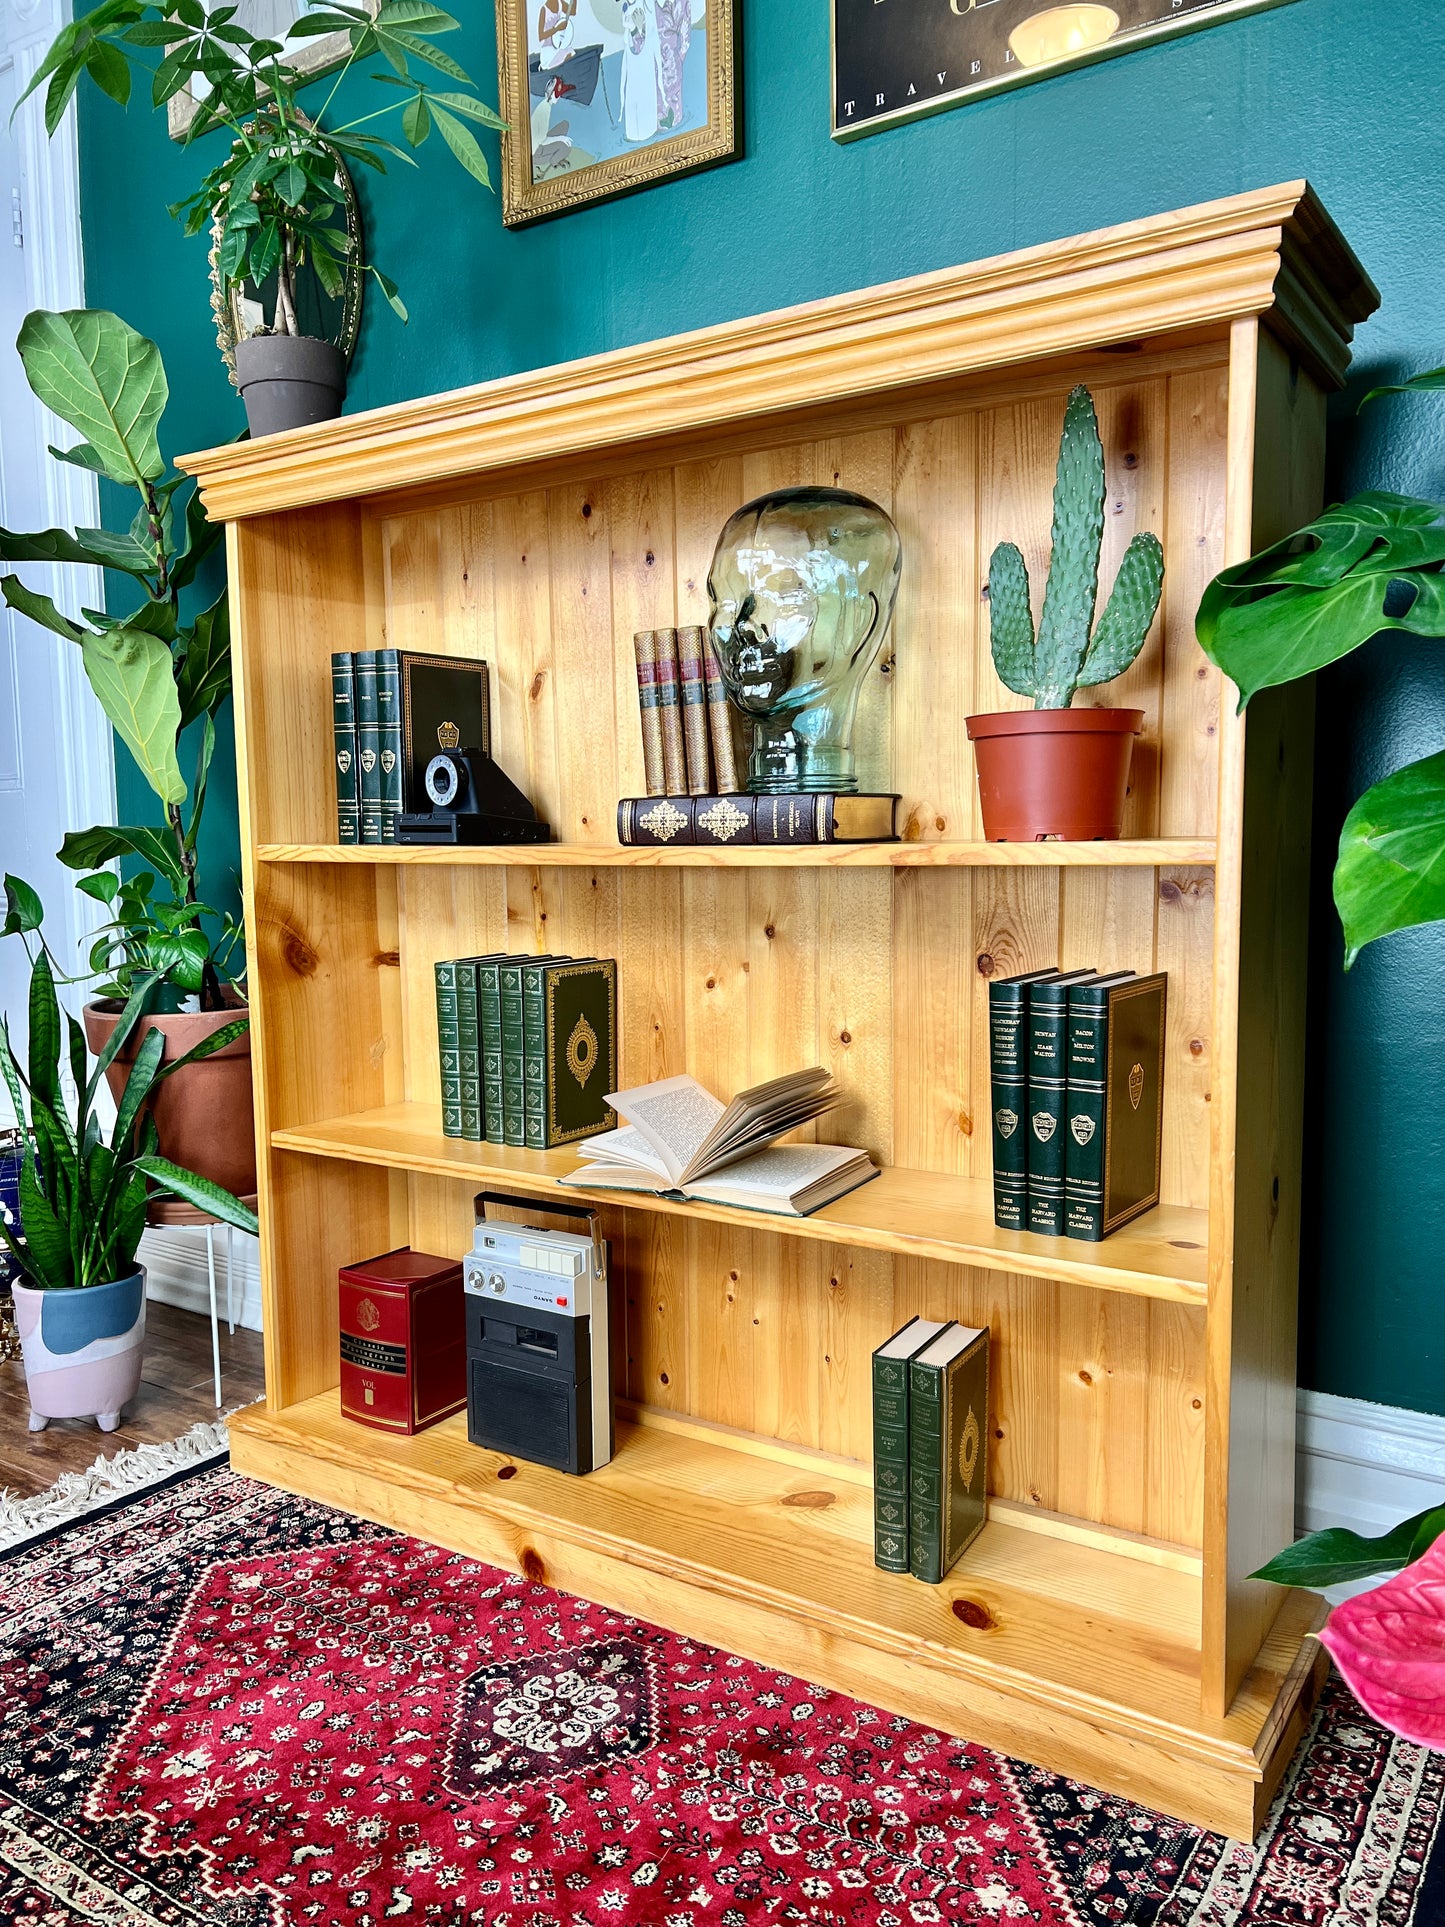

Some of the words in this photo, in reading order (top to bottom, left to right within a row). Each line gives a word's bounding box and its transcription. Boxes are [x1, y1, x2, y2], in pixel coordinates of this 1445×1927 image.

[1031, 1209, 1056, 1218] HARVARD
[1068, 1213, 1093, 1222] HARVARD
[1031, 1217, 1056, 1226] CLASSICS
[1068, 1221, 1093, 1230] CLASSICS
[533, 1295, 553, 1303] SANYO
[353, 1339, 385, 1350] Classic
[346, 1343, 395, 1362] Photograph
[352, 1357, 386, 1371] Library
